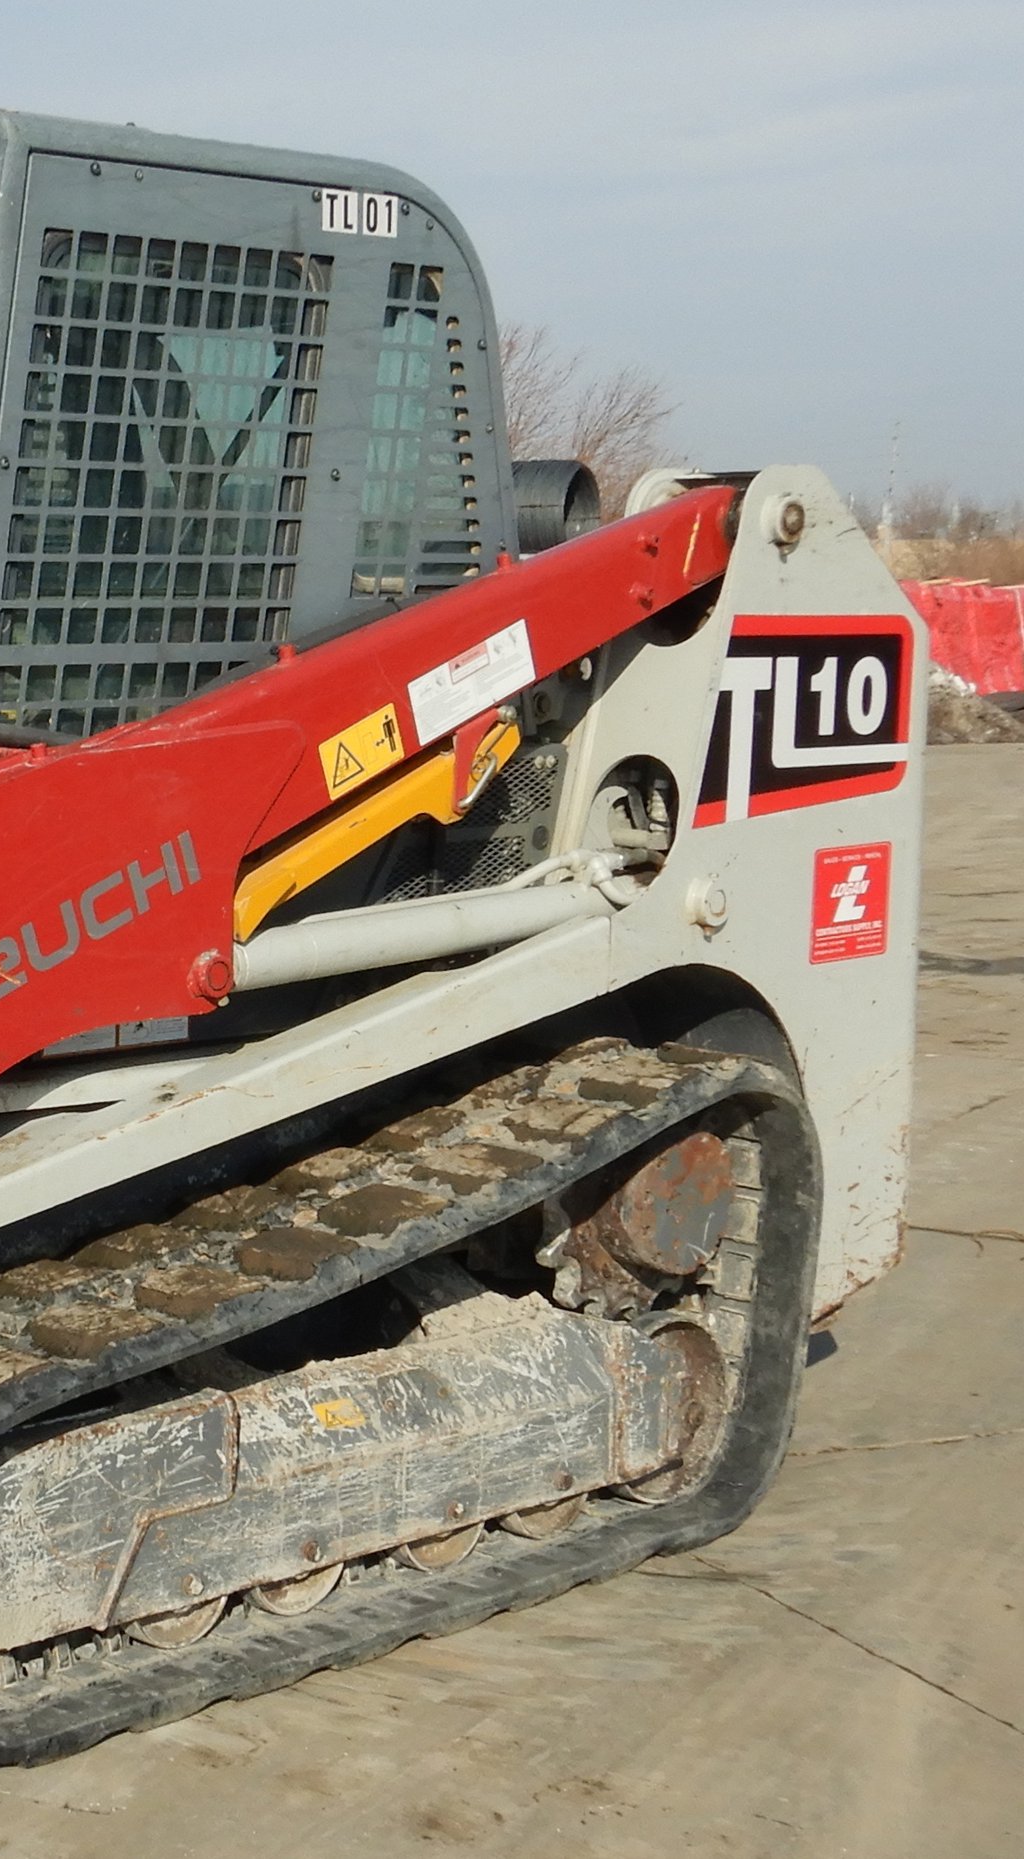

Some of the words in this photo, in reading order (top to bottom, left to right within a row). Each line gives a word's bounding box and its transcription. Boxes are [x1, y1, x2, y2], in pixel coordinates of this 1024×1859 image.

[326, 193, 353, 230] TL
[366, 197, 393, 234] 01
[719, 656, 908, 822] TL10
